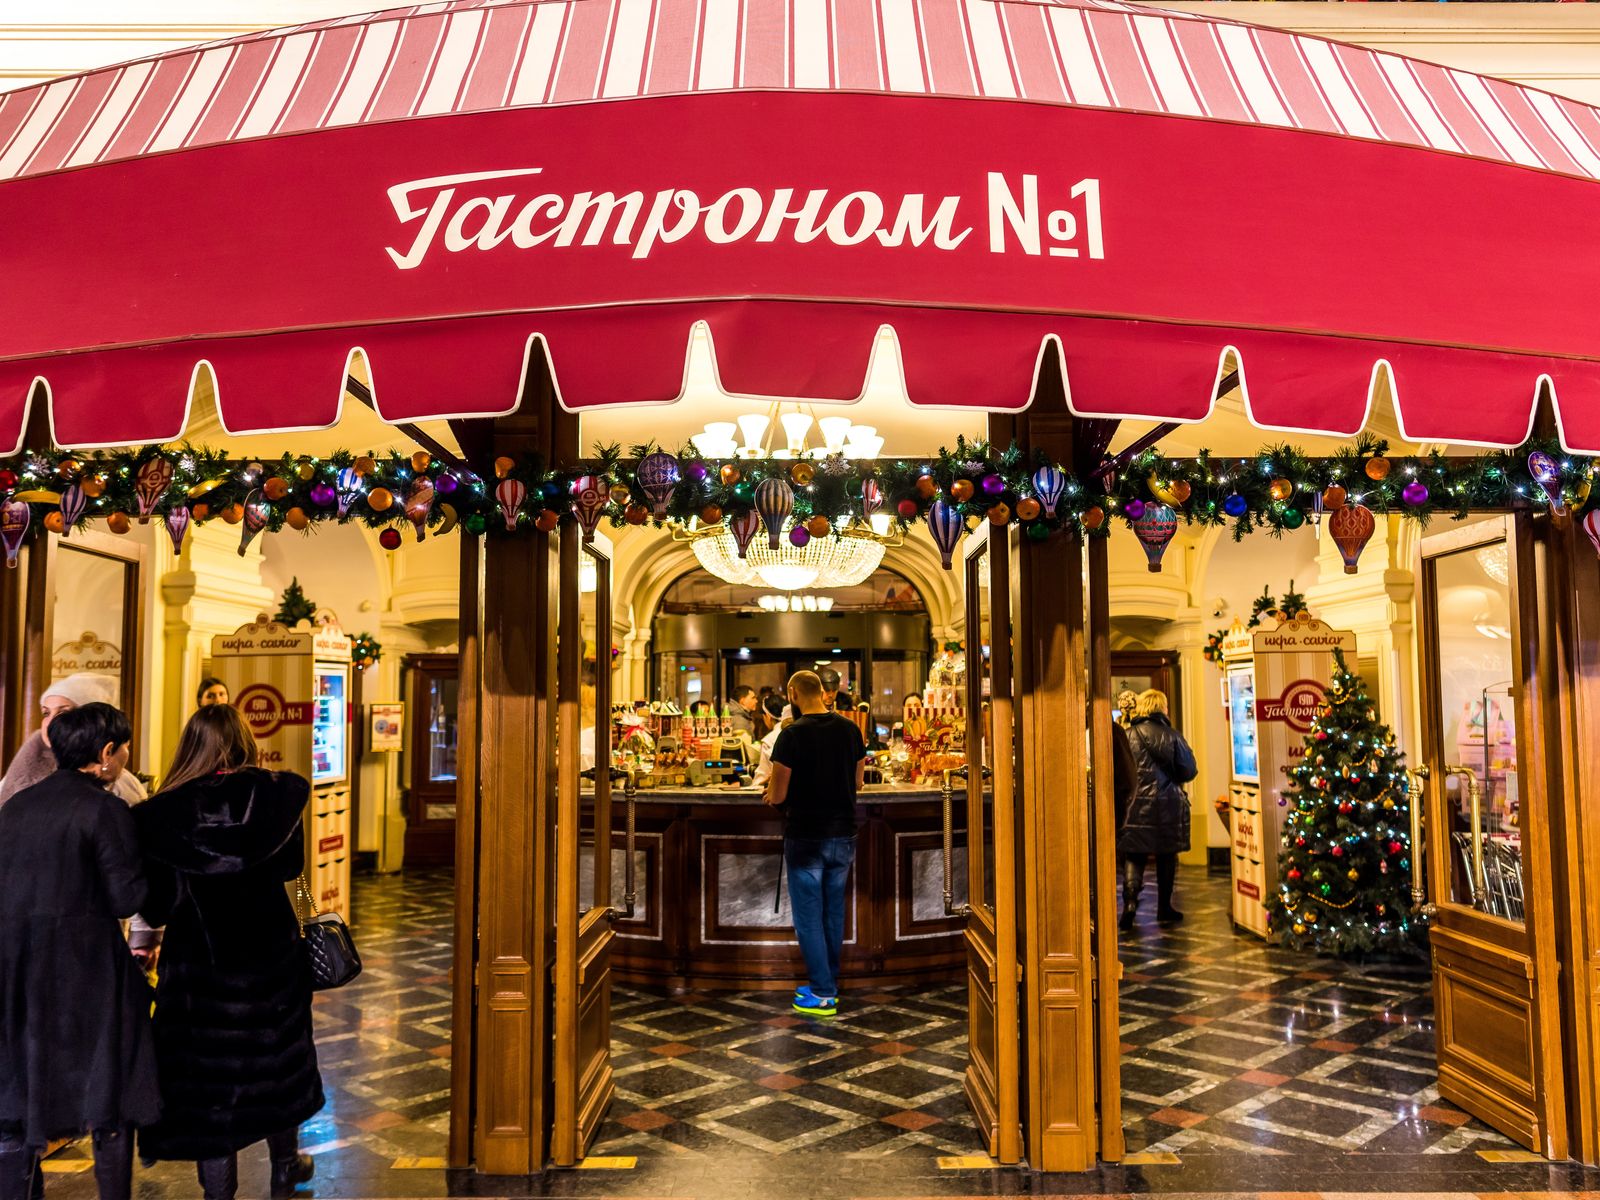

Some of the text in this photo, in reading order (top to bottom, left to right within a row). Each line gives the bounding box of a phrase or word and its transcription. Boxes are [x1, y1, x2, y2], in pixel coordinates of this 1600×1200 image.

[386, 167, 1105, 270] Гастроном №1
[222, 635, 301, 652] икра caviar
[1264, 632, 1344, 650] икра caviar
[86, 656, 121, 669] cavia
[1264, 704, 1318, 719] Гастрон
